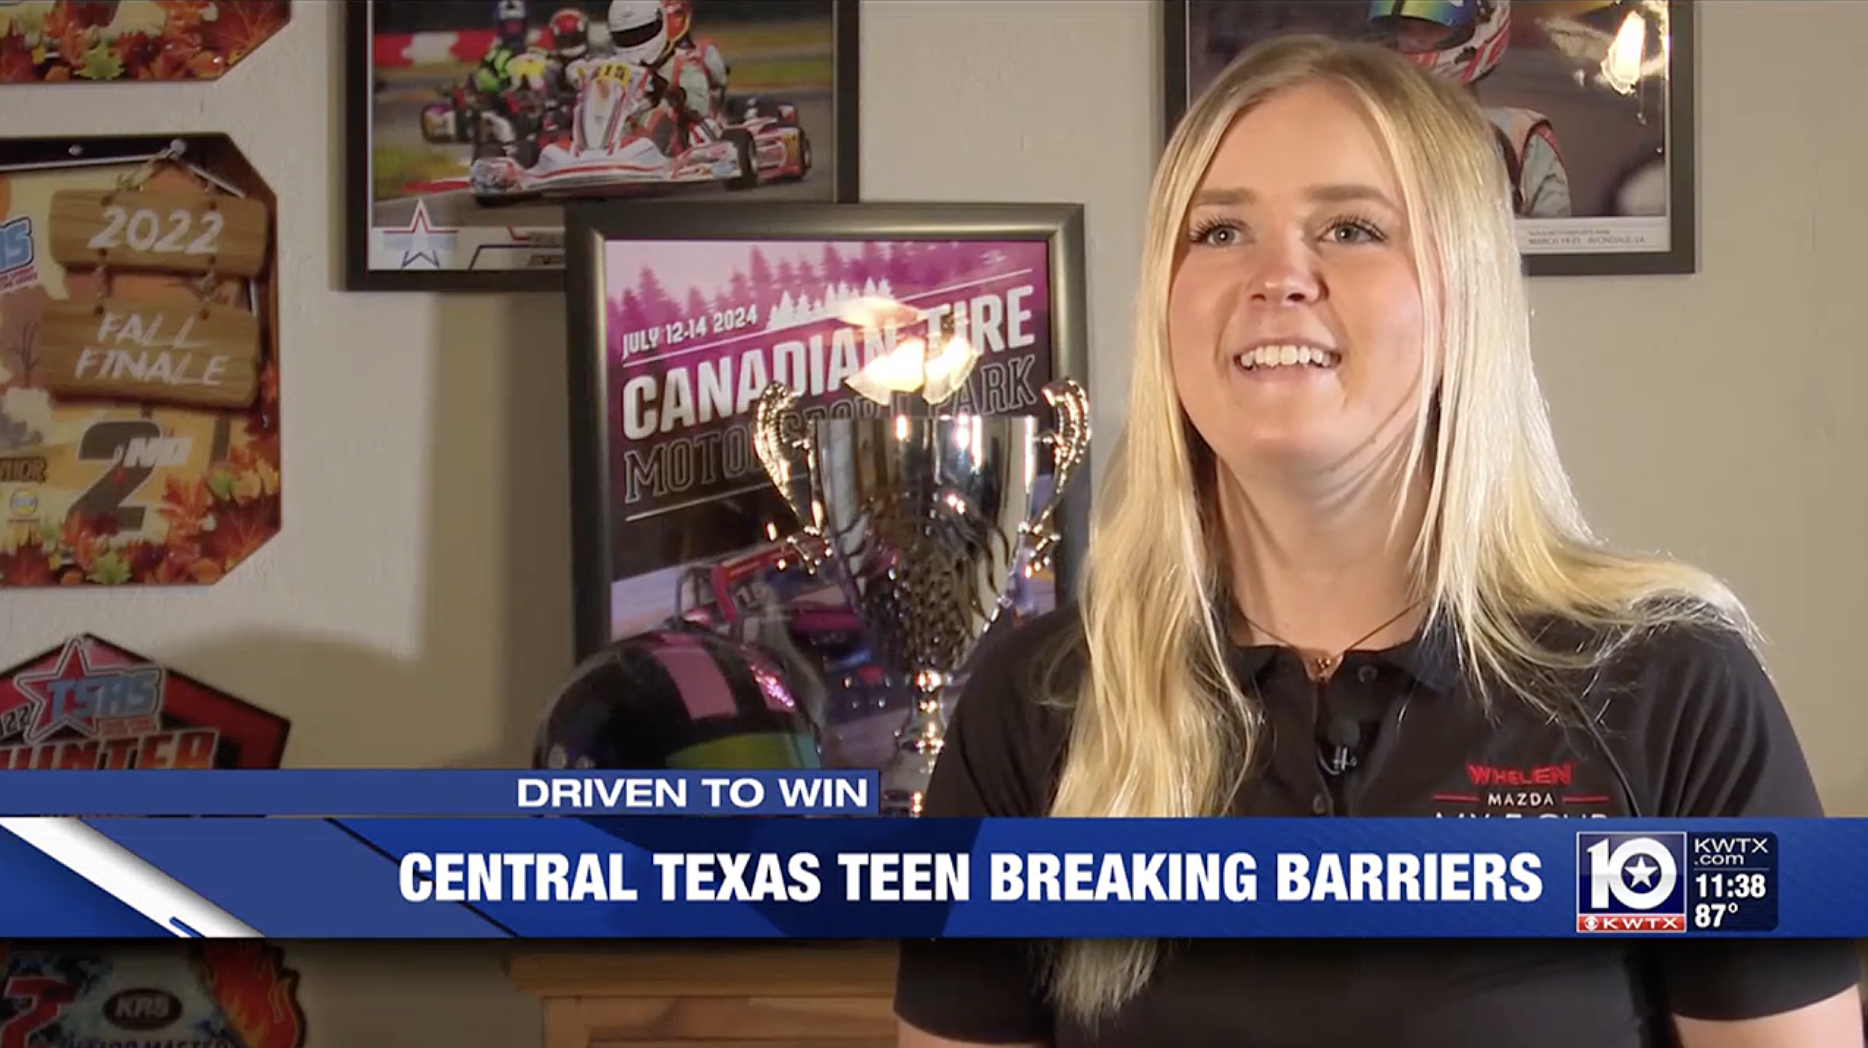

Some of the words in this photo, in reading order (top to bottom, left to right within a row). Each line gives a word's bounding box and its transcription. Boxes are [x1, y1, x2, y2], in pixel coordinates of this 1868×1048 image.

[88, 205, 223, 254] 2022
[97, 311, 208, 349] FALL
[622, 327, 660, 361] JULY
[665, 316, 707, 344] 12-14
[713, 304, 758, 333] 2024
[926, 285, 1036, 356] TIRE
[75, 346, 230, 385] FINALE
[935, 354, 1037, 417] ARK
[1466, 761, 1574, 785] WHELEN
[1487, 793, 1554, 806] MAZDA
